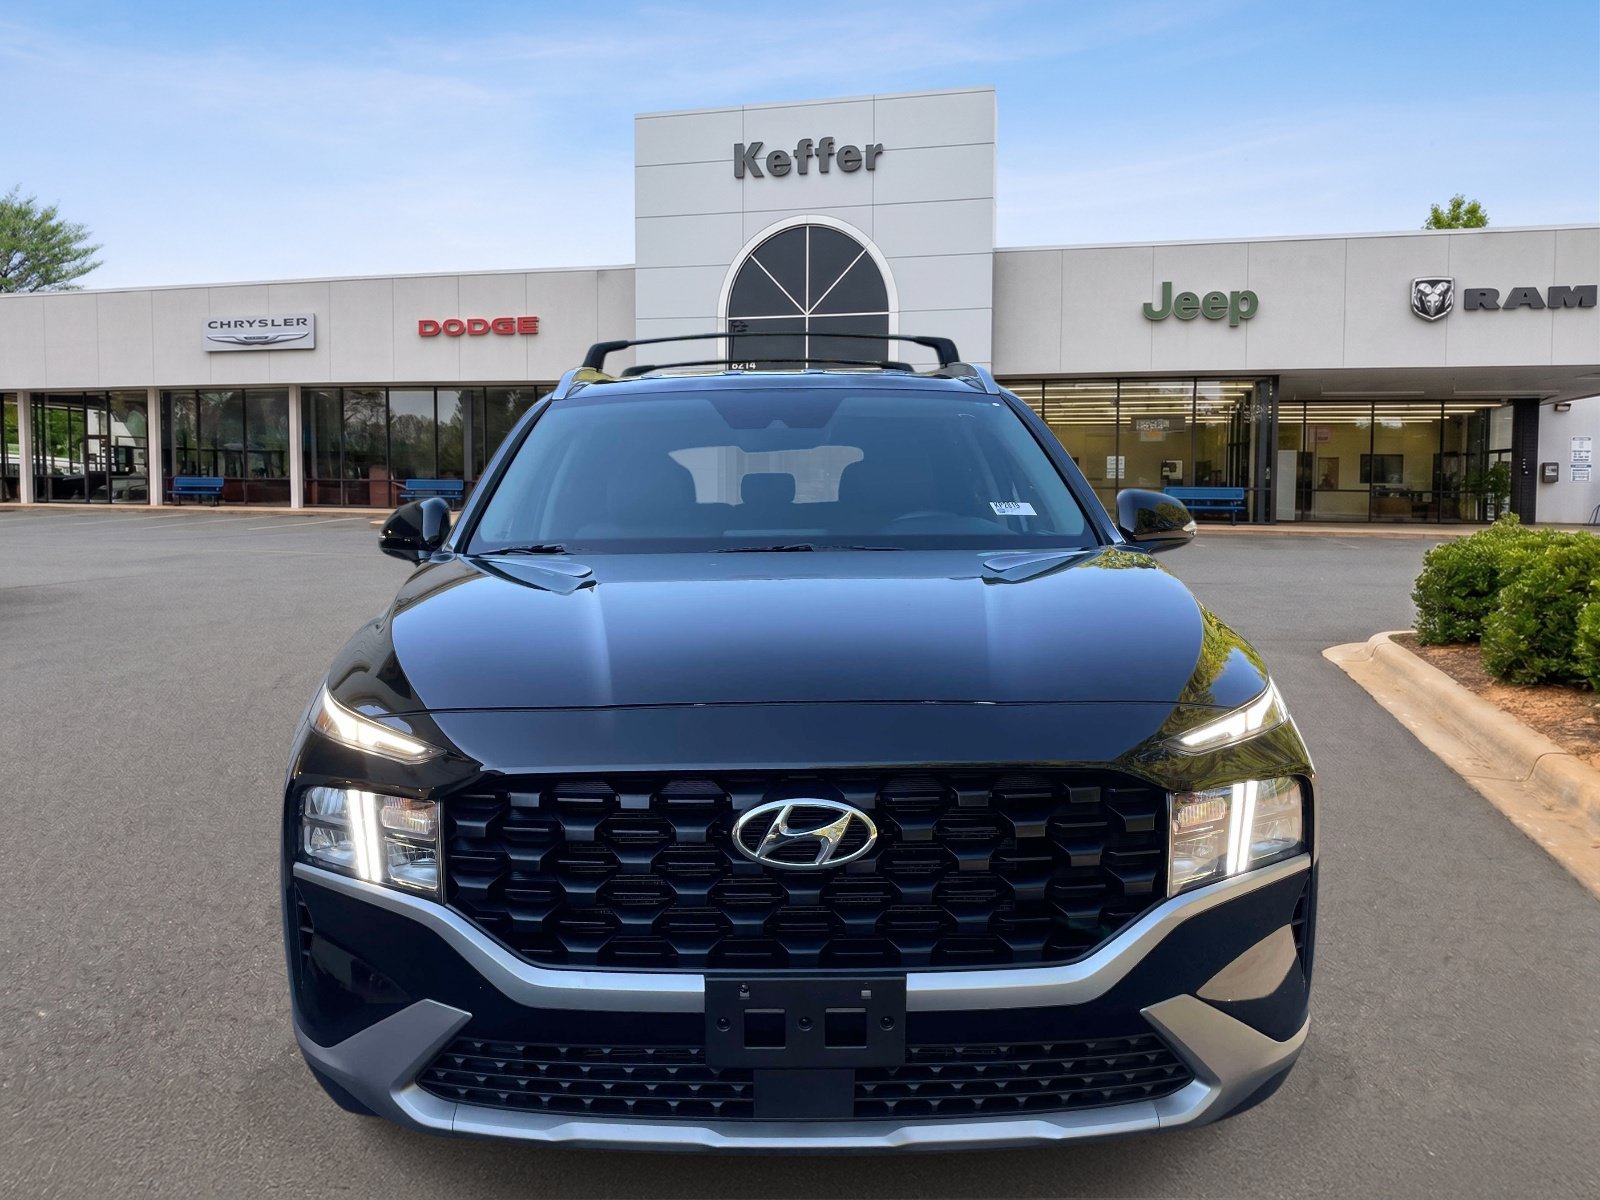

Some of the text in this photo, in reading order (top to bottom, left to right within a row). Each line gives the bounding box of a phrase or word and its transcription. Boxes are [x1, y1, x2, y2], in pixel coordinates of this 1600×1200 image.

[733, 136, 883, 179] Keffer
[1142, 281, 1259, 327] Jeep
[1464, 284, 1598, 311] RAM
[207, 317, 308, 330] CHRYSLER
[418, 316, 539, 337] DODGE
